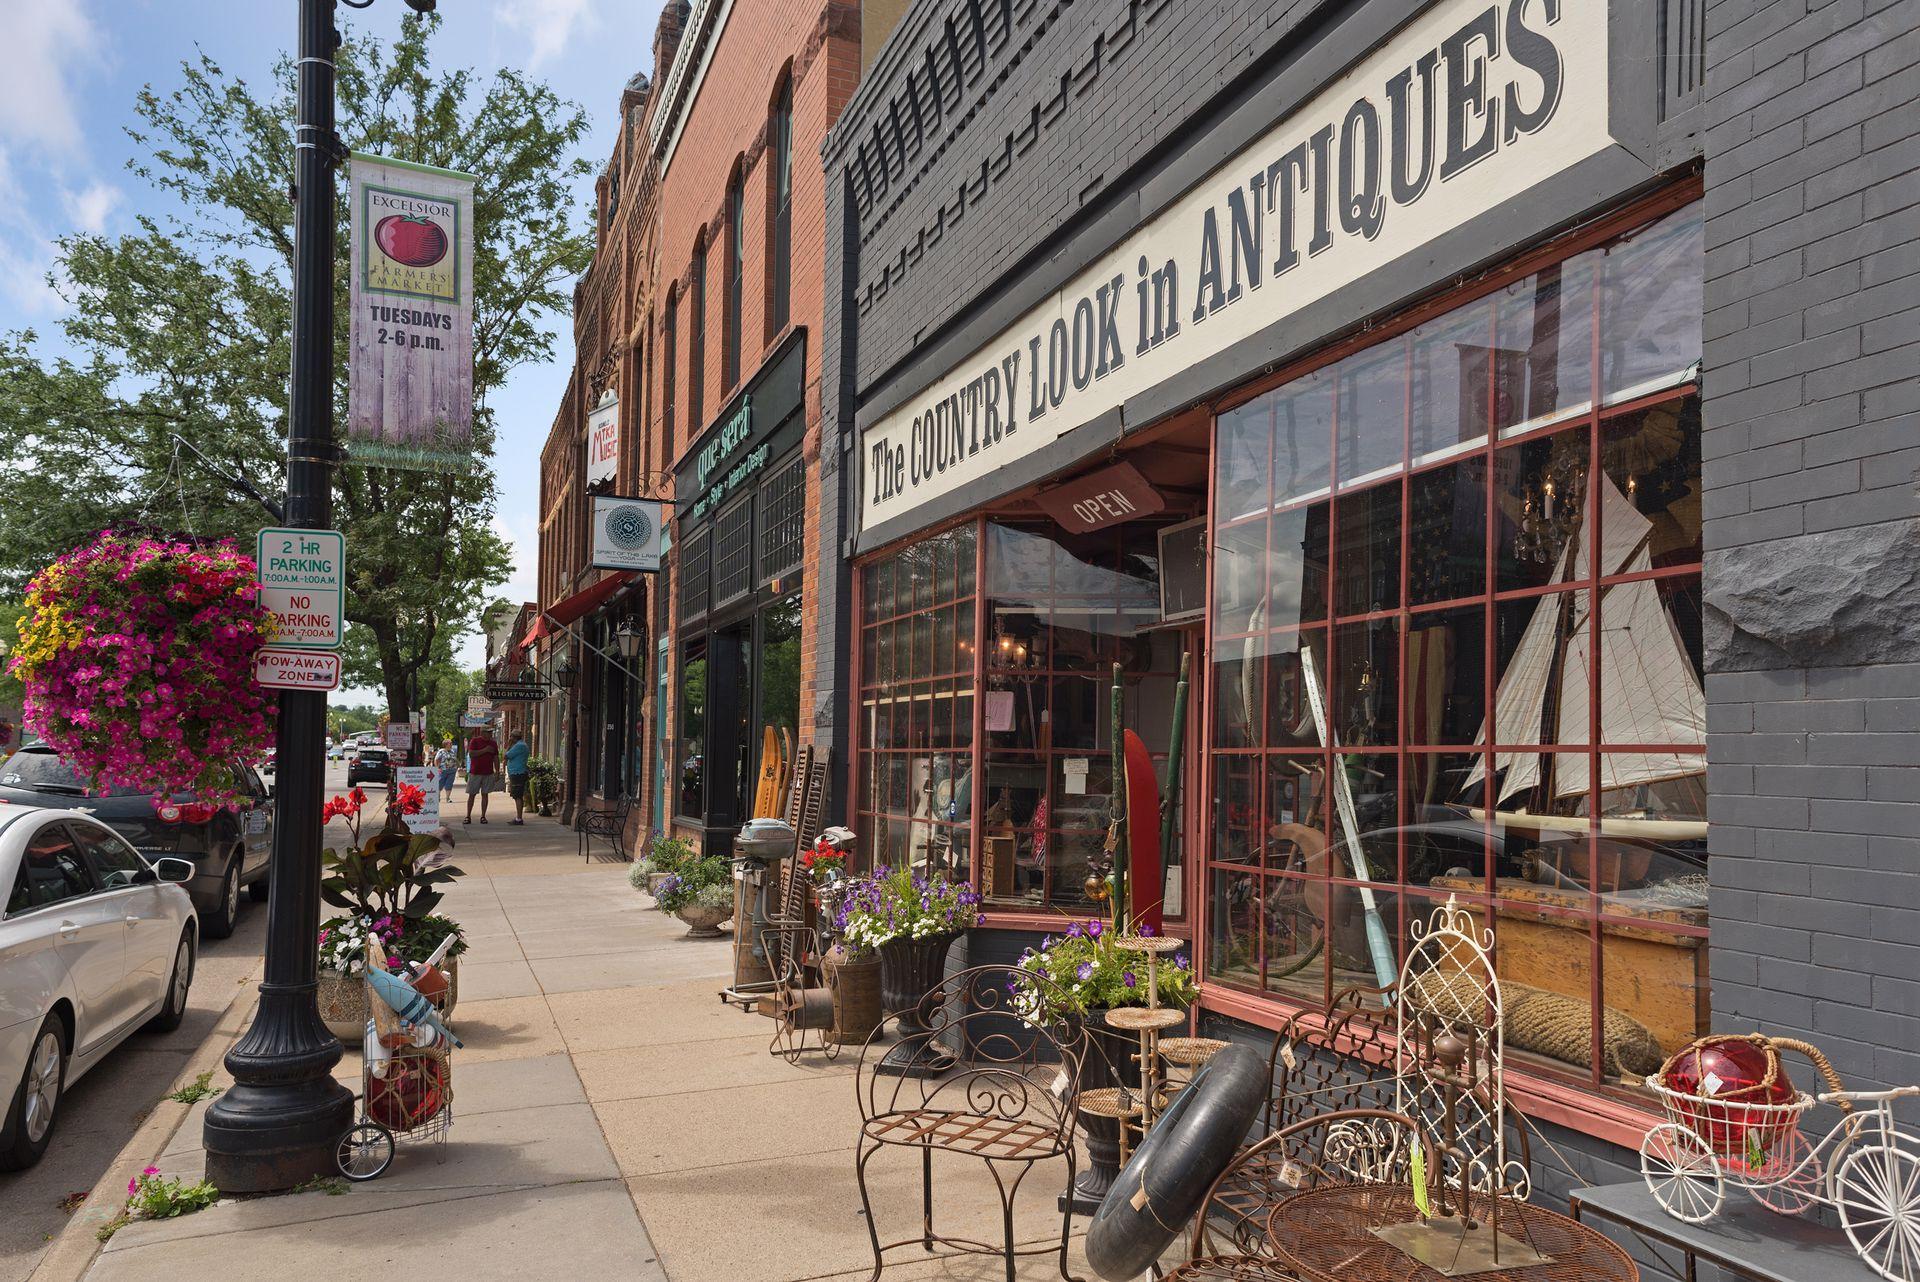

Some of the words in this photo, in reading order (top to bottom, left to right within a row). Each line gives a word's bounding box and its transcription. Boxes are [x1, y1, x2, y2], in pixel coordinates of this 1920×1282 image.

[373, 195, 451, 218] EXCELSIOR
[872, 437, 905, 506] The
[910, 349, 1021, 488] COUNTRY
[1028, 272, 1125, 423] LOOK
[1136, 254, 1180, 358] in
[1192, 0, 1564, 324] ANTIQUES
[373, 264, 450, 283] FARMERS'
[377, 276, 443, 293] MARKET
[370, 305, 452, 330] TUESDAYS
[377, 328, 406, 346] 2-6
[410, 333, 445, 351] p.m.
[698, 438, 720, 491] que
[747, 443, 769, 473] Design
[1072, 489, 1137, 524] OPEN
[282, 541, 292, 554] 2
[301, 541, 320, 555] HR
[270, 558, 332, 573] PARKING
[290, 596, 310, 610] NO
[271, 613, 331, 628] PARKING
[265, 656, 334, 670] TOW-AWAY
[278, 670, 314, 682] ZONE
[486, 690, 546, 698] BRIGHTWATER
